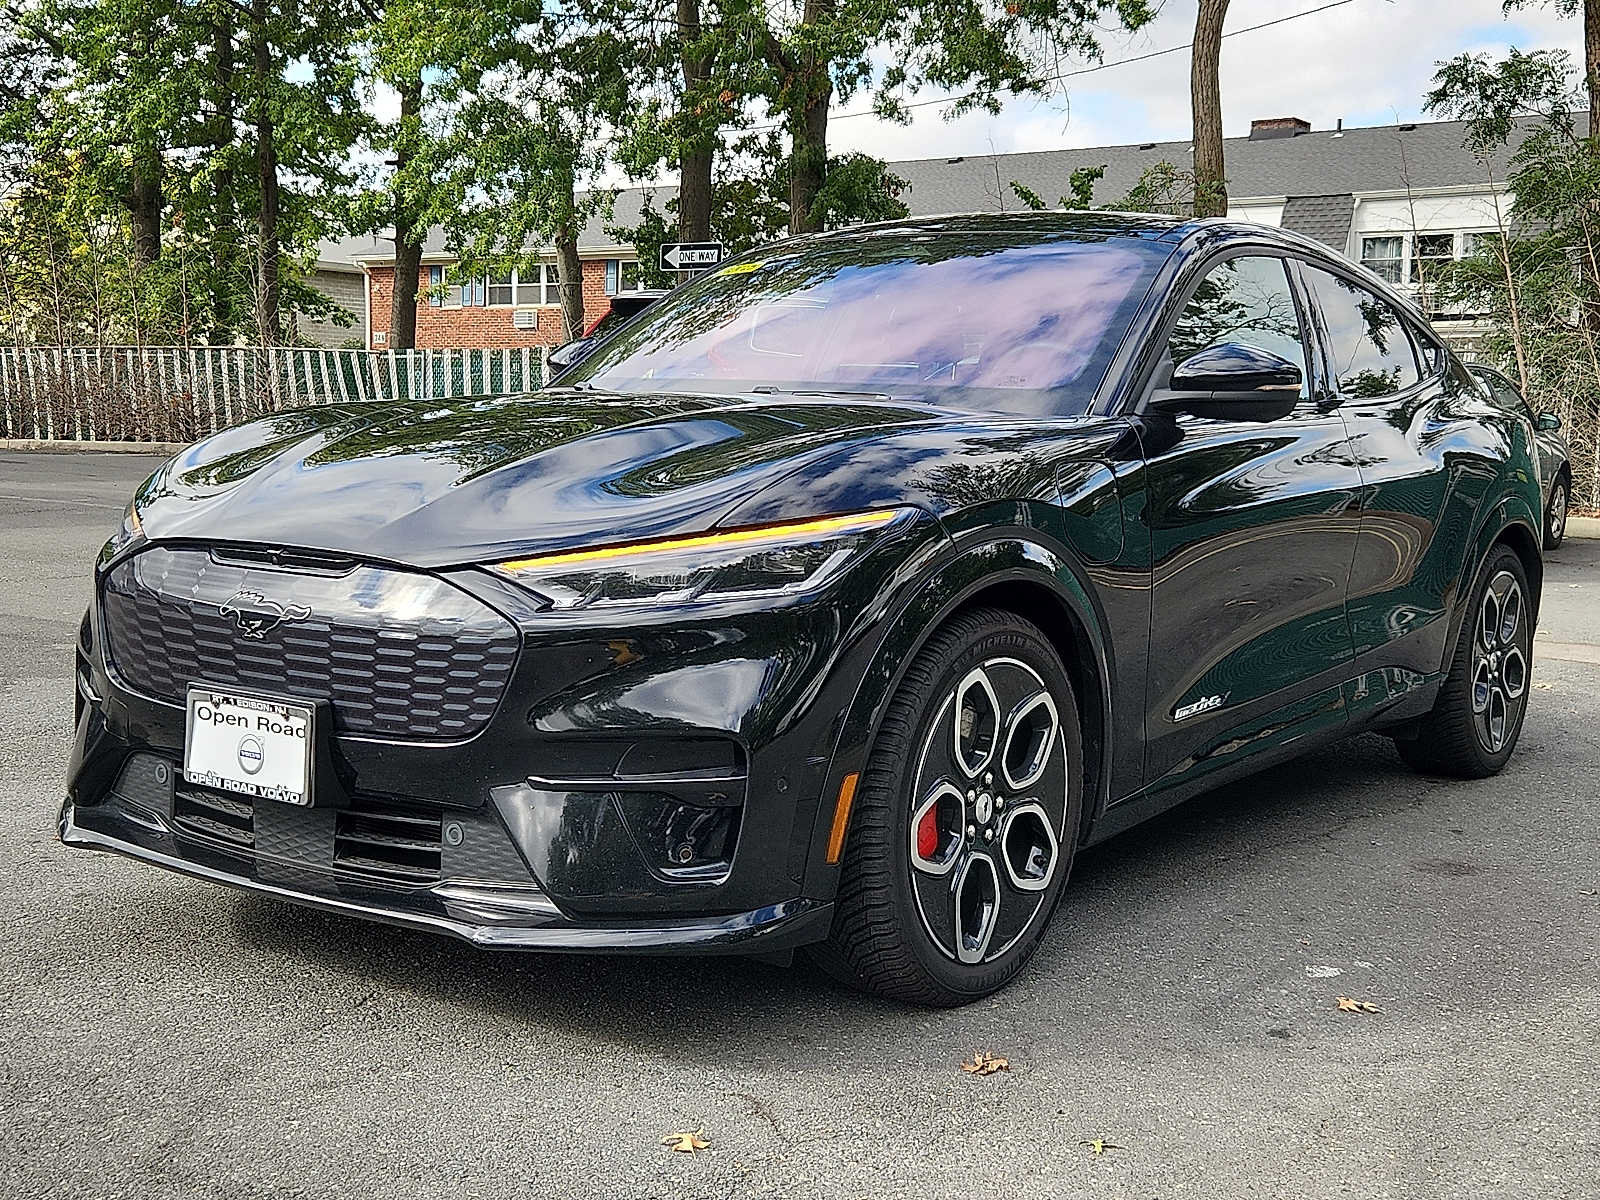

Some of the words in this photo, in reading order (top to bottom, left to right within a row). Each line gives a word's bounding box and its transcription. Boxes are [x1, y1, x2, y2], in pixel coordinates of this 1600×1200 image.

[679, 251, 696, 262] ONE
[698, 250, 716, 261] WAY
[973, 635, 1025, 657] MICHELIN
[275, 705, 287, 714] NJ
[197, 706, 249, 728] Open
[257, 716, 306, 738] Road
[190, 772, 221, 787] OPEN
[224, 779, 257, 795] ROAD
[259, 786, 300, 803] VOLVO
